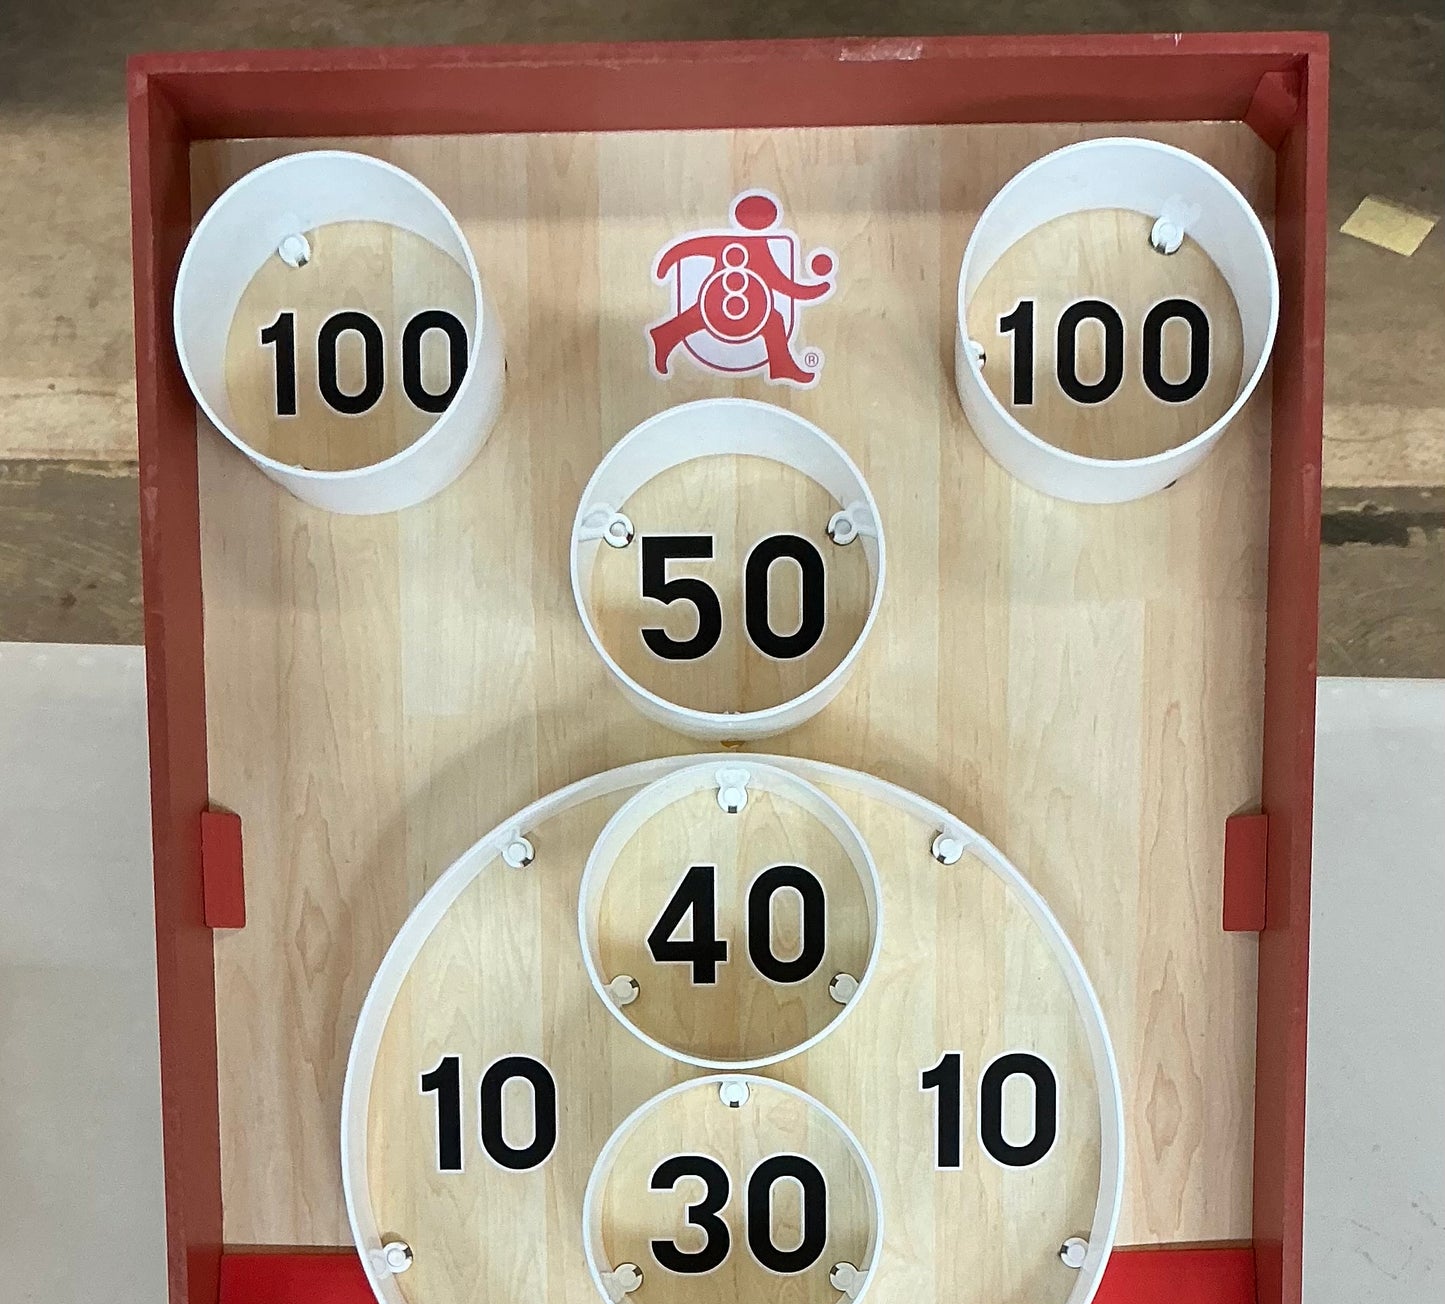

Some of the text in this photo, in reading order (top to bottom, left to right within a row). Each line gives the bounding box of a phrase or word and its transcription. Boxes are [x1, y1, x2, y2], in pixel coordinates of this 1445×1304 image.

[260, 310, 468, 415] 100
[999, 298, 1211, 405] 100
[640, 534, 826, 661] 50
[646, 865, 826, 984] 40
[420, 1055, 558, 1171] 10
[921, 1052, 1058, 1168] 10
[649, 1154, 828, 1274] 30
